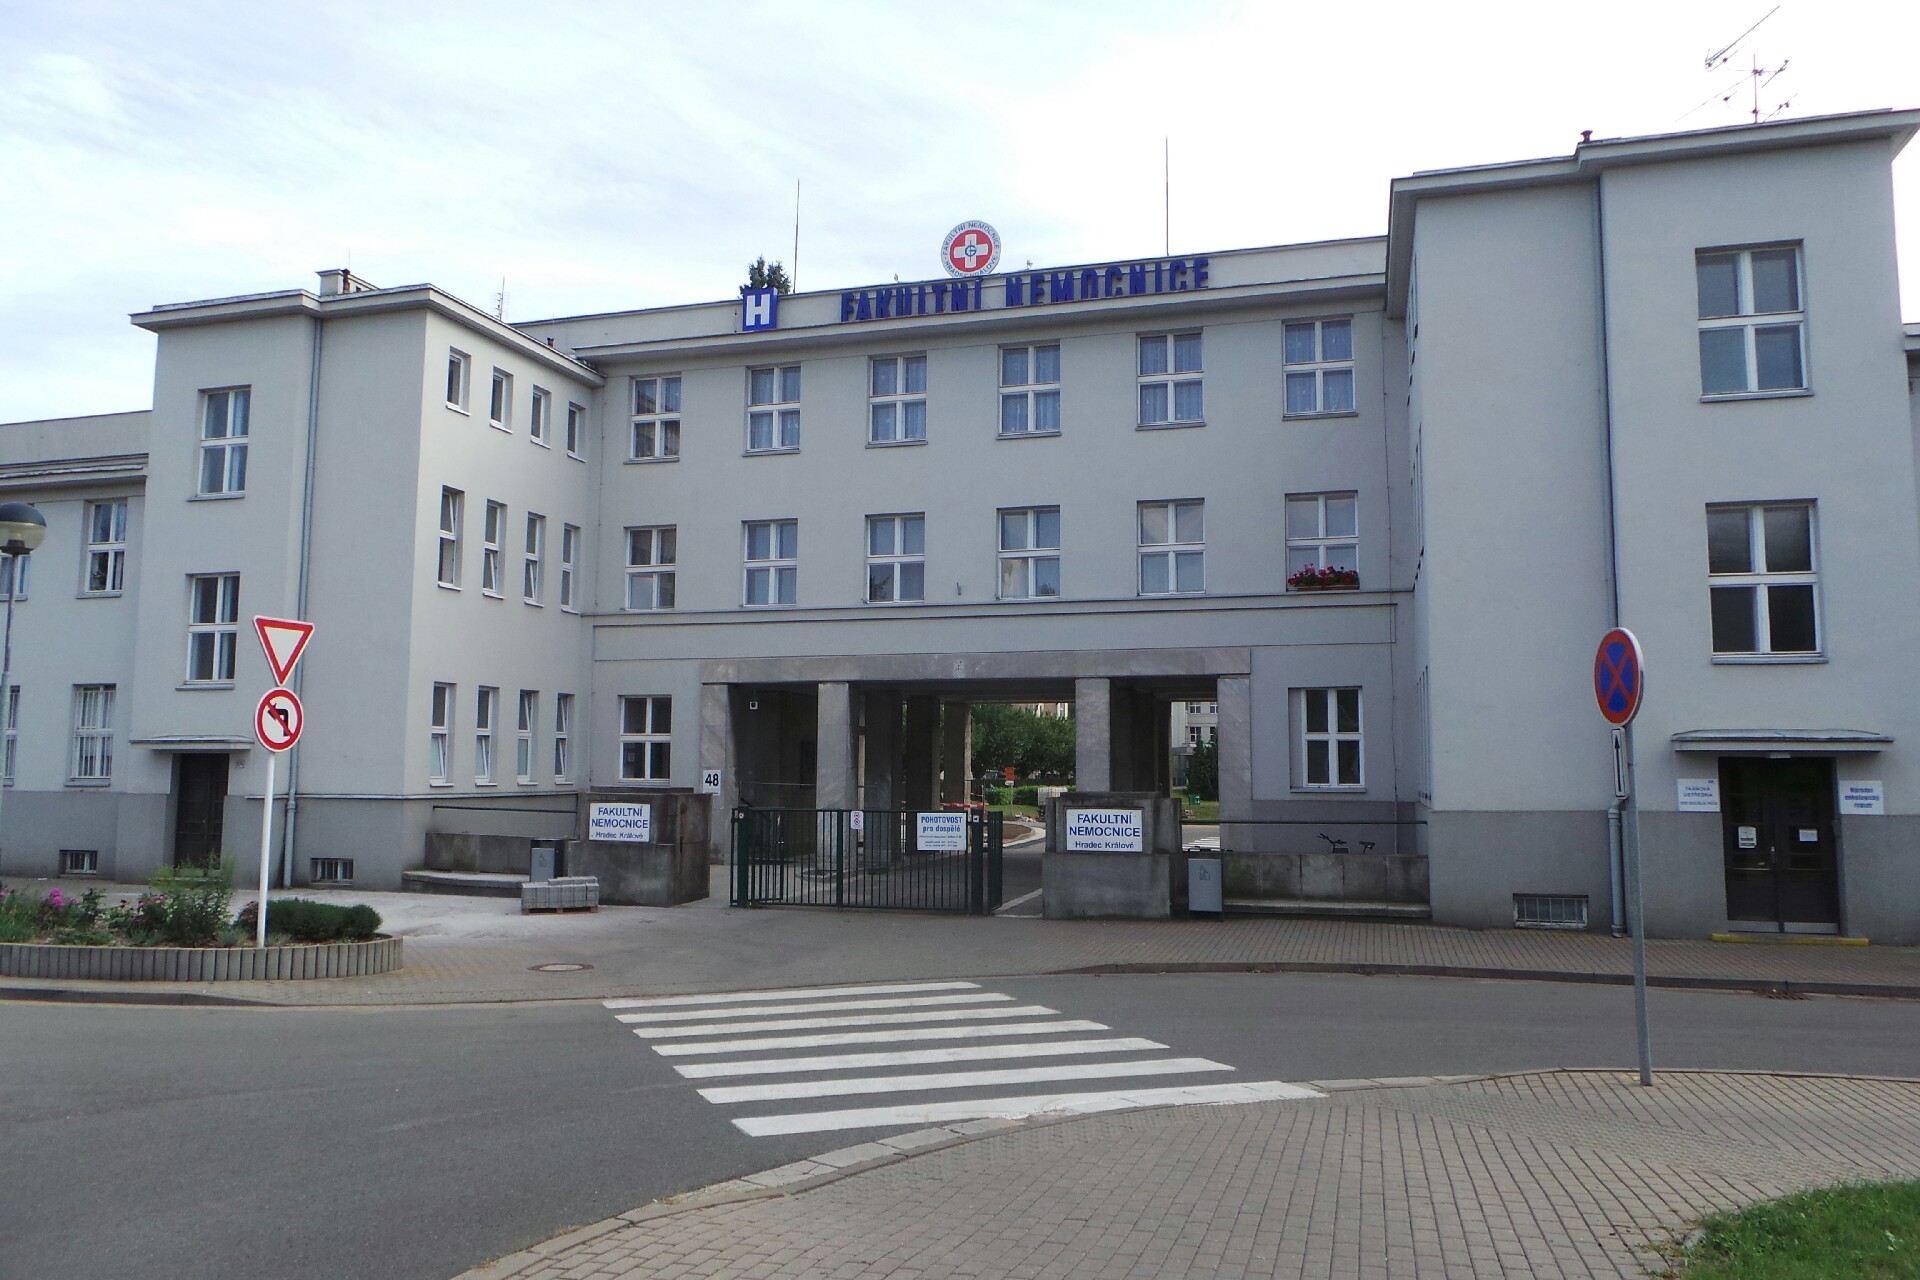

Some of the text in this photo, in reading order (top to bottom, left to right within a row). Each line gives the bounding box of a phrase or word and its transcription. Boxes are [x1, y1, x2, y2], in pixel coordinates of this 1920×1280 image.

[1006, 257, 1209, 307] NEMOCNICE
[704, 773, 719, 787] 48
[598, 805, 644, 818] FAKULTNÍ
[591, 818, 649, 829] NEMOCNICE
[921, 816, 963, 824] POHOTOVOST
[1077, 812, 1132, 825] FAKULTNÍ
[935, 824, 961, 834] dospělé
[1069, 826, 1141, 837] NEMOCNICE
[595, 831, 644, 840] Hradec Králové
[1075, 840, 1135, 849] Hradec Králové
